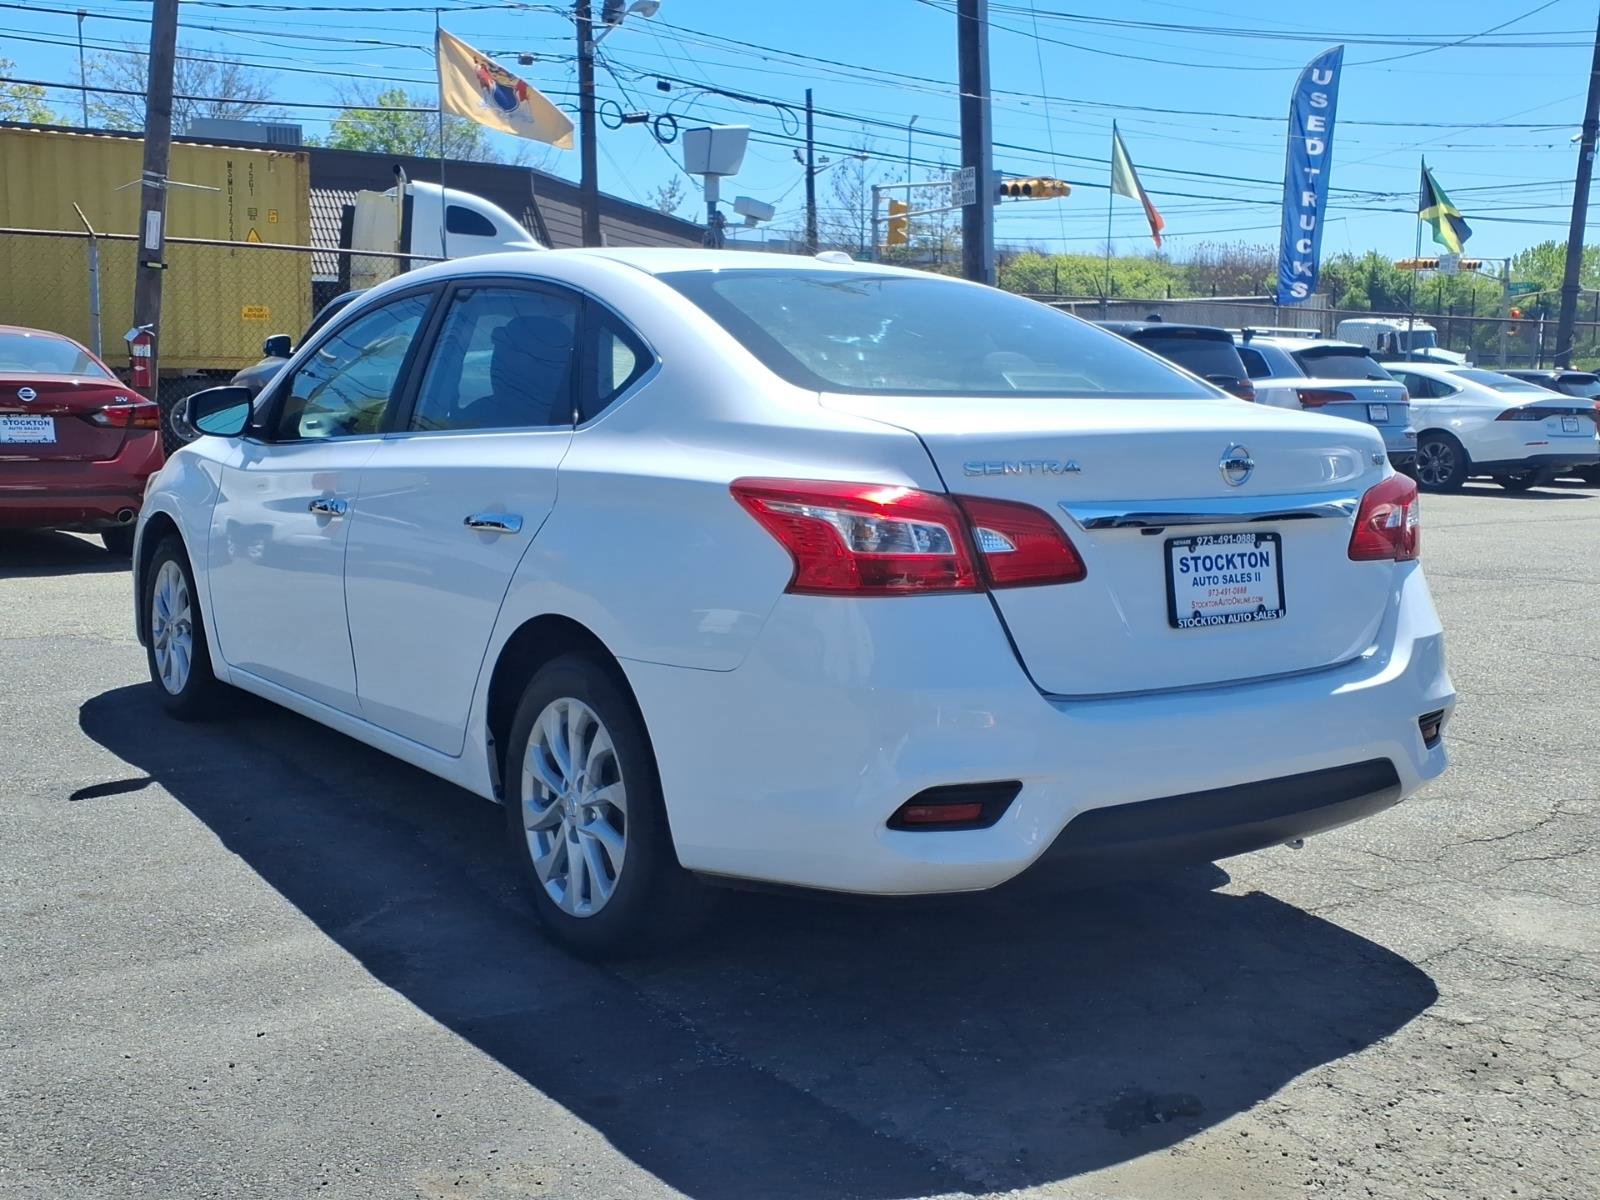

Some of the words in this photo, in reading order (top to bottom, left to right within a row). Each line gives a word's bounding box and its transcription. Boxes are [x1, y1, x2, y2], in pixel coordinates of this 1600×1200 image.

[1304, 68, 1333, 156] USED
[1290, 167, 1320, 298] TRUCKS
[963, 460, 1081, 477] SENTRA
[1196, 533, 1256, 546] 973-491-0888
[1179, 551, 1270, 574] STOCKTON
[1192, 575, 1220, 587] AUTO
[1222, 573, 1252, 584] SALES
[1255, 572, 1261, 582] II
[1208, 586, 1248, 597] 973-491-0888
[1178, 616, 1226, 629] STOCKTON
[1228, 613, 1252, 625] AUTO
[1254, 610, 1277, 621] SALES
